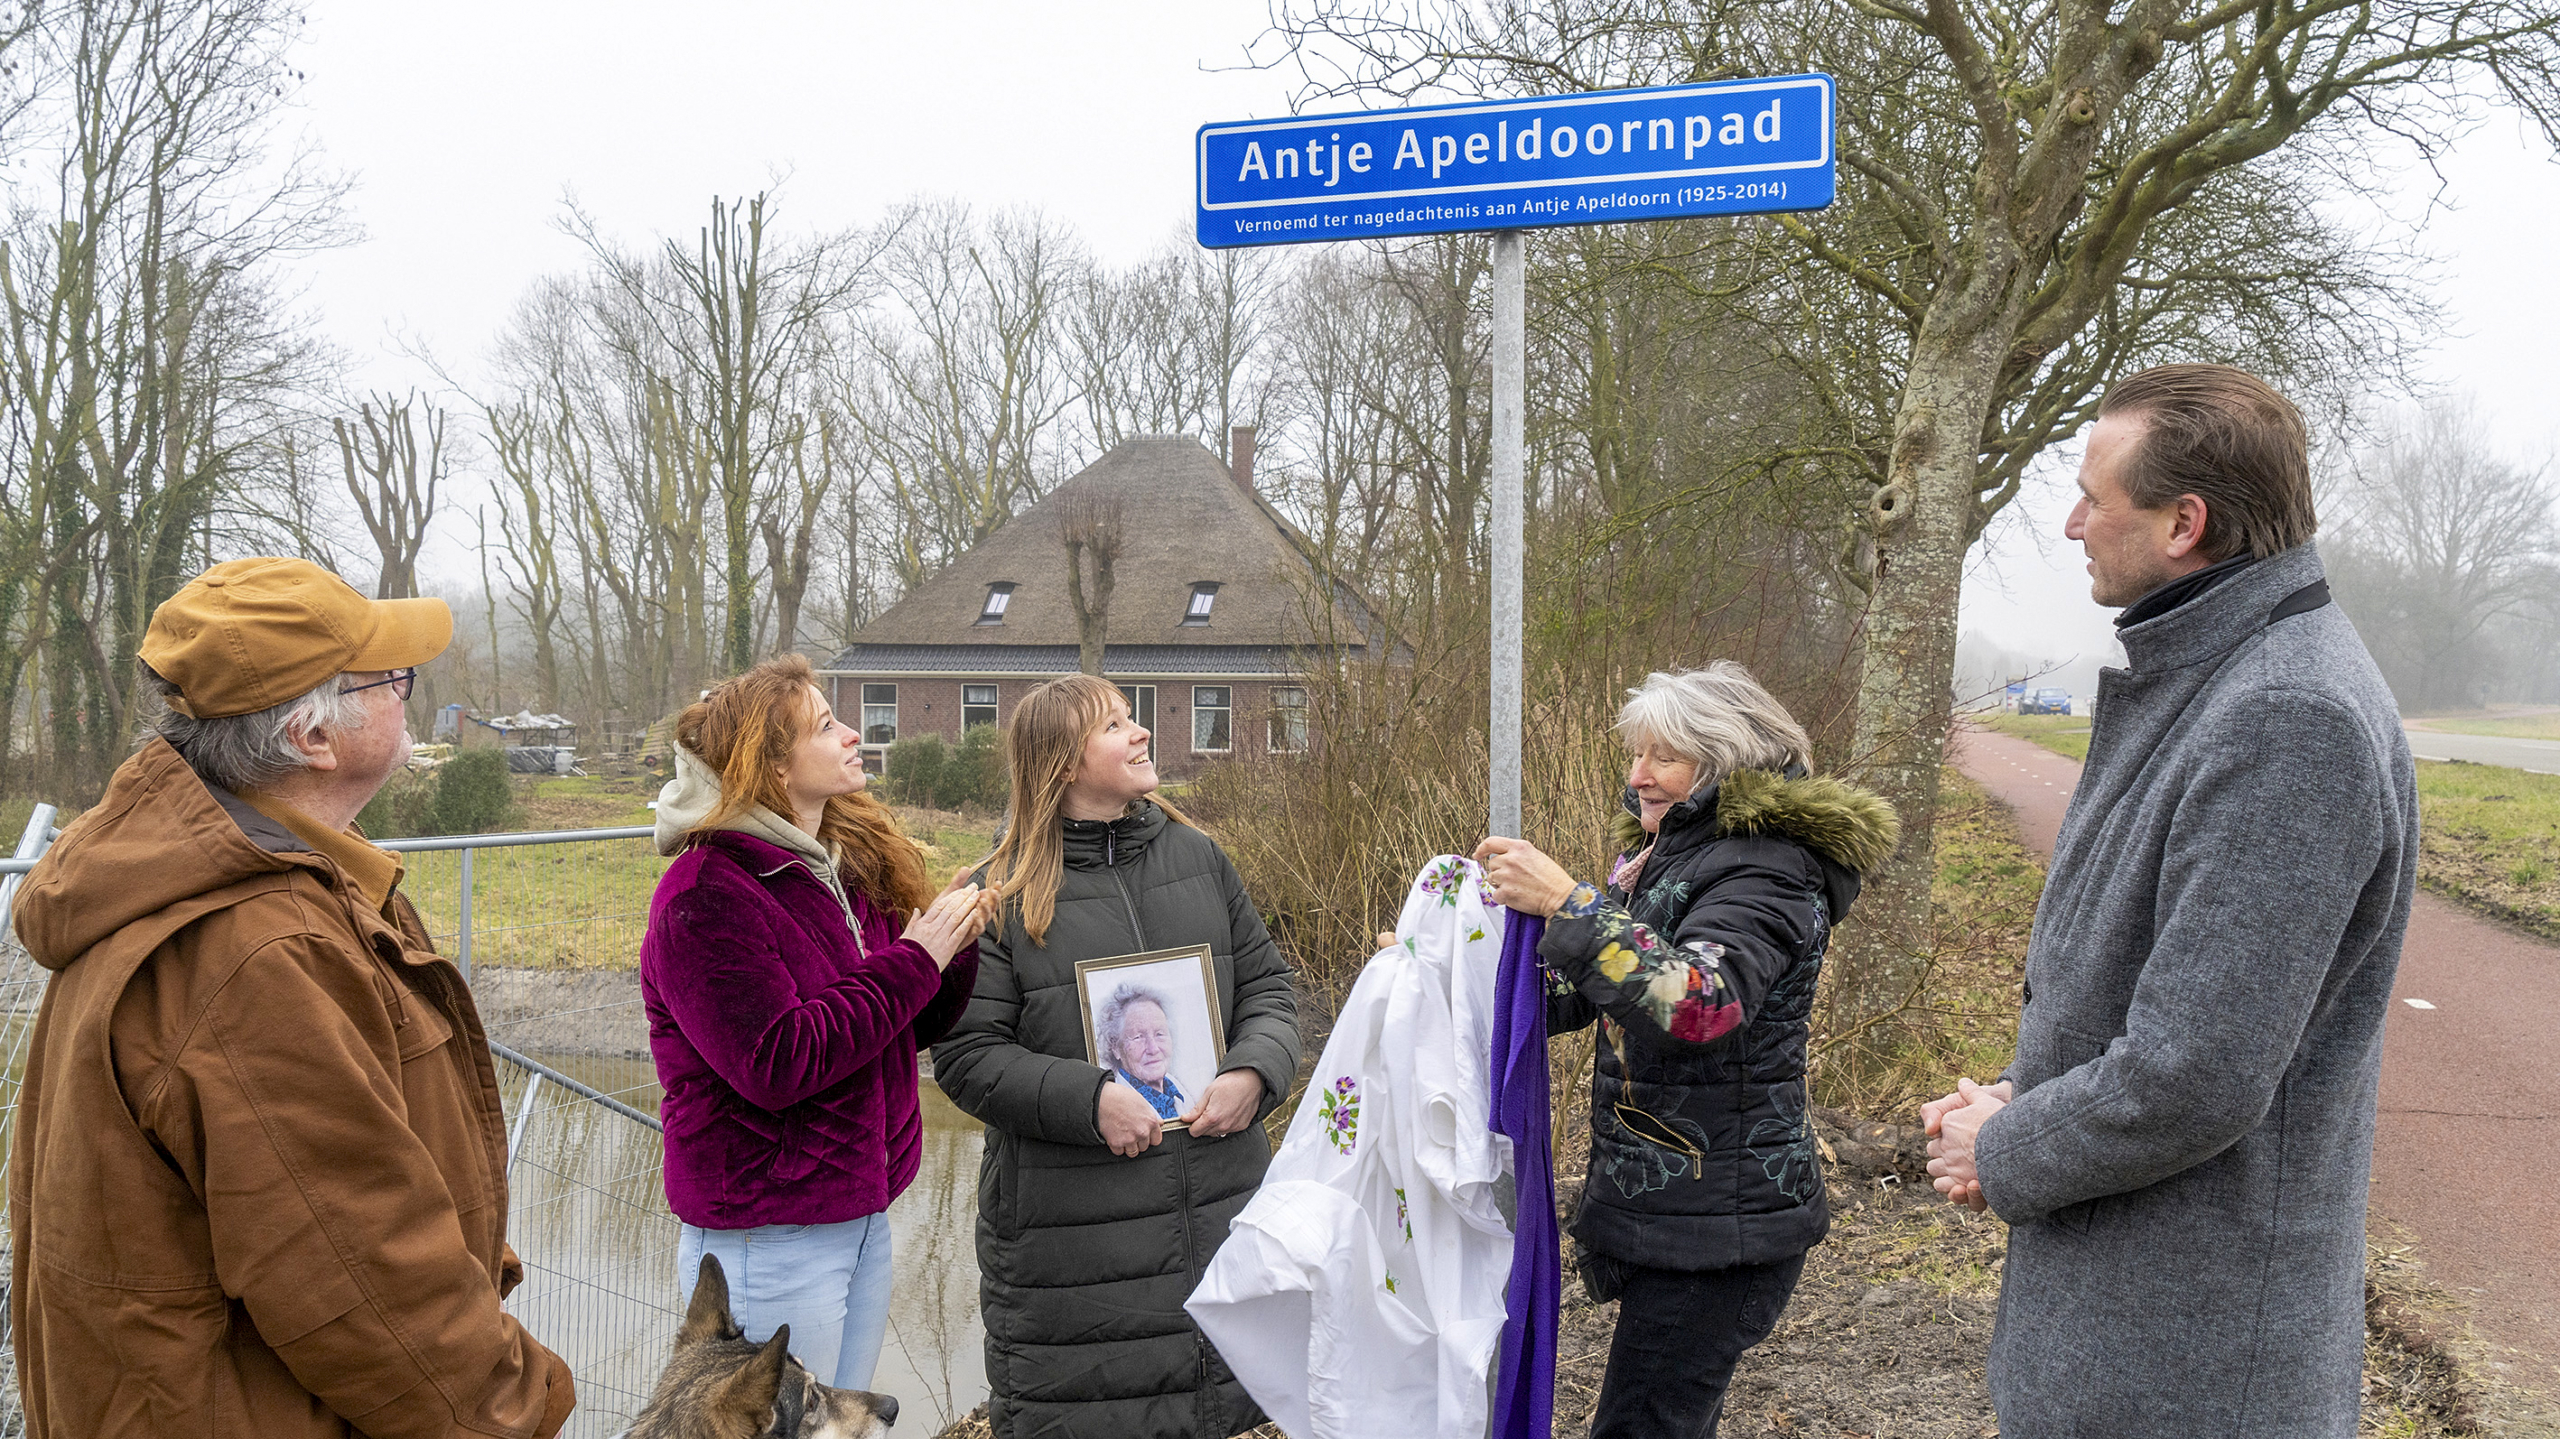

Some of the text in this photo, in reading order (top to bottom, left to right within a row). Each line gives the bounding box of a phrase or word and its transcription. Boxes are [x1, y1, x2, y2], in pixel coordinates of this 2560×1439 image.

[1238, 98, 1781, 187] Antje Apeldoornpad
[1234, 181, 1788, 233] Vernoemd ter nagedachtenis aan Antje Apeldoorn (1925-2014)
